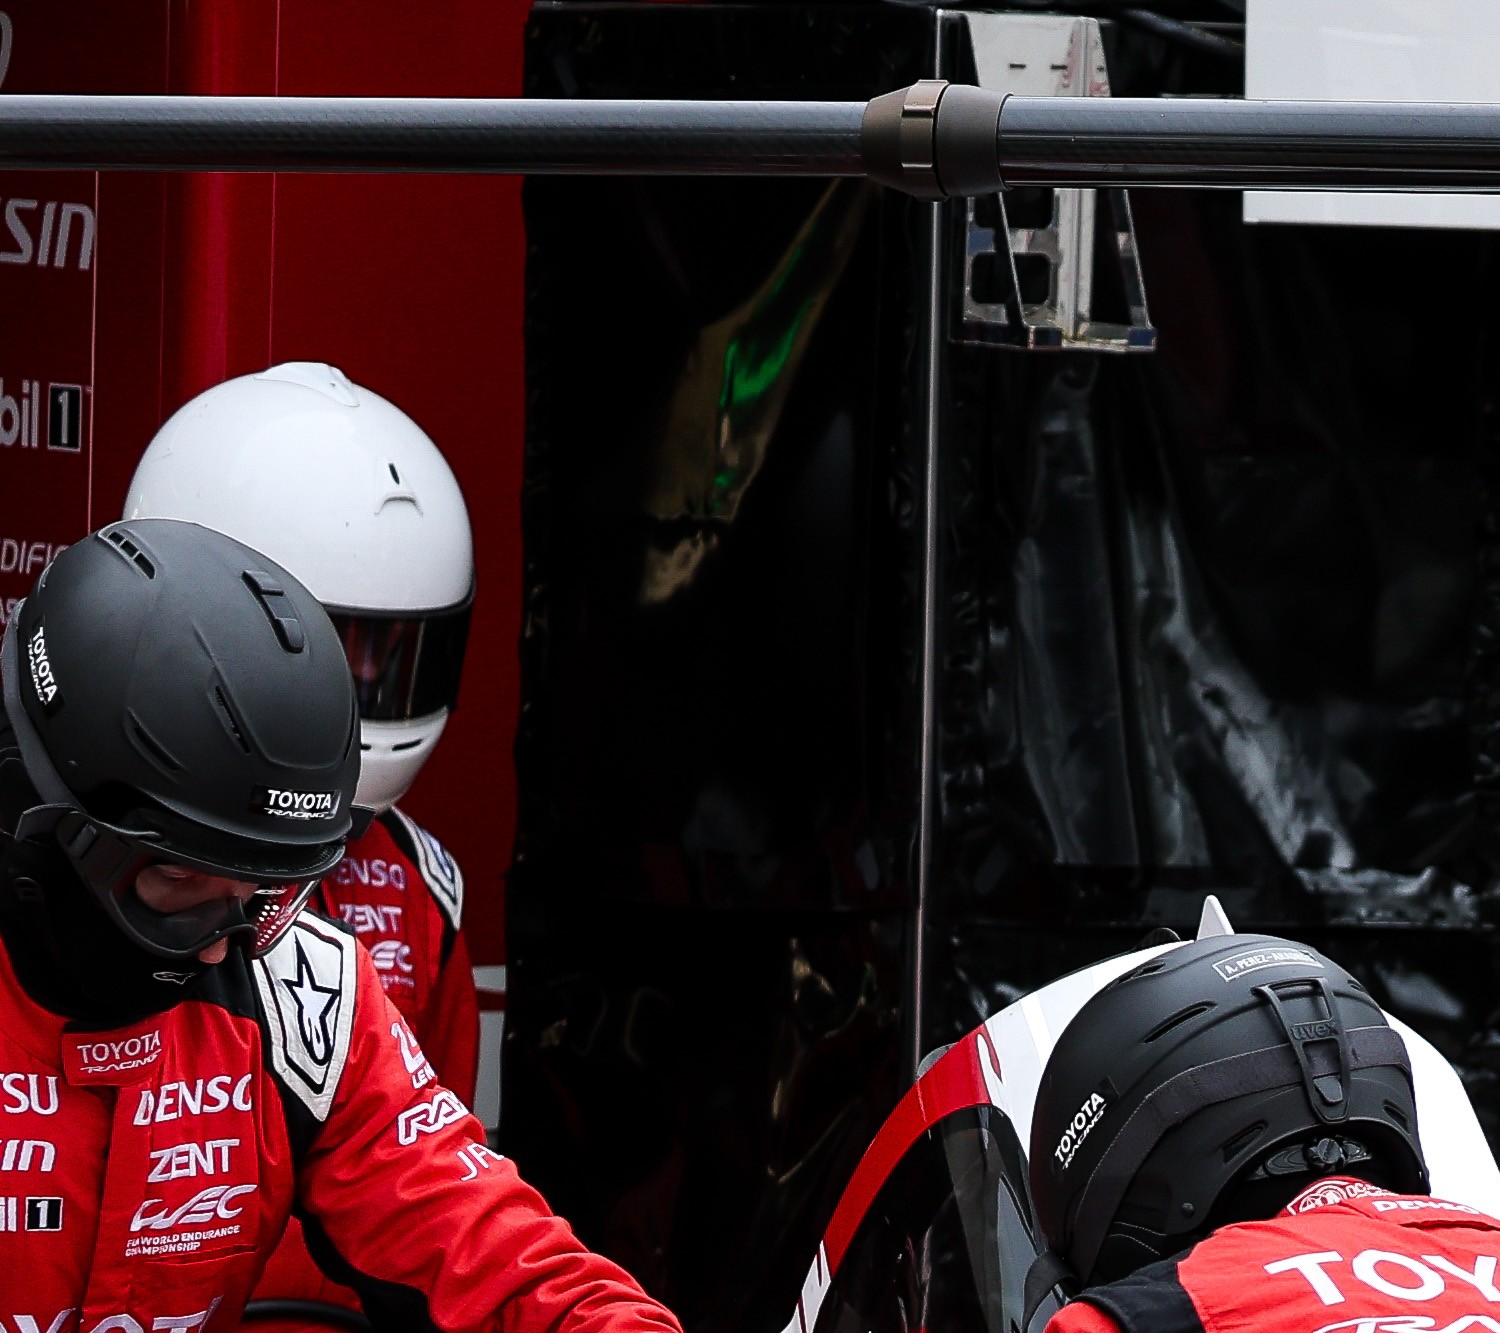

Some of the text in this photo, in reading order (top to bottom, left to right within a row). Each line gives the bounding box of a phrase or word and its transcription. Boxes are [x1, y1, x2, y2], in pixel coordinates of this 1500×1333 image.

[0, 199, 95, 270] SIN
[31, 626, 58, 702] TOYOTA
[267, 789, 332, 810] TOYOTA
[77, 1030, 160, 1063] TOYOTA
[80, 1049, 162, 1073] RACING
[1054, 1092, 1105, 1162] TOYOTA
[147, 1138, 240, 1183] ZENT
[142, 1225, 241, 1245] WORLD ENDURANCE
